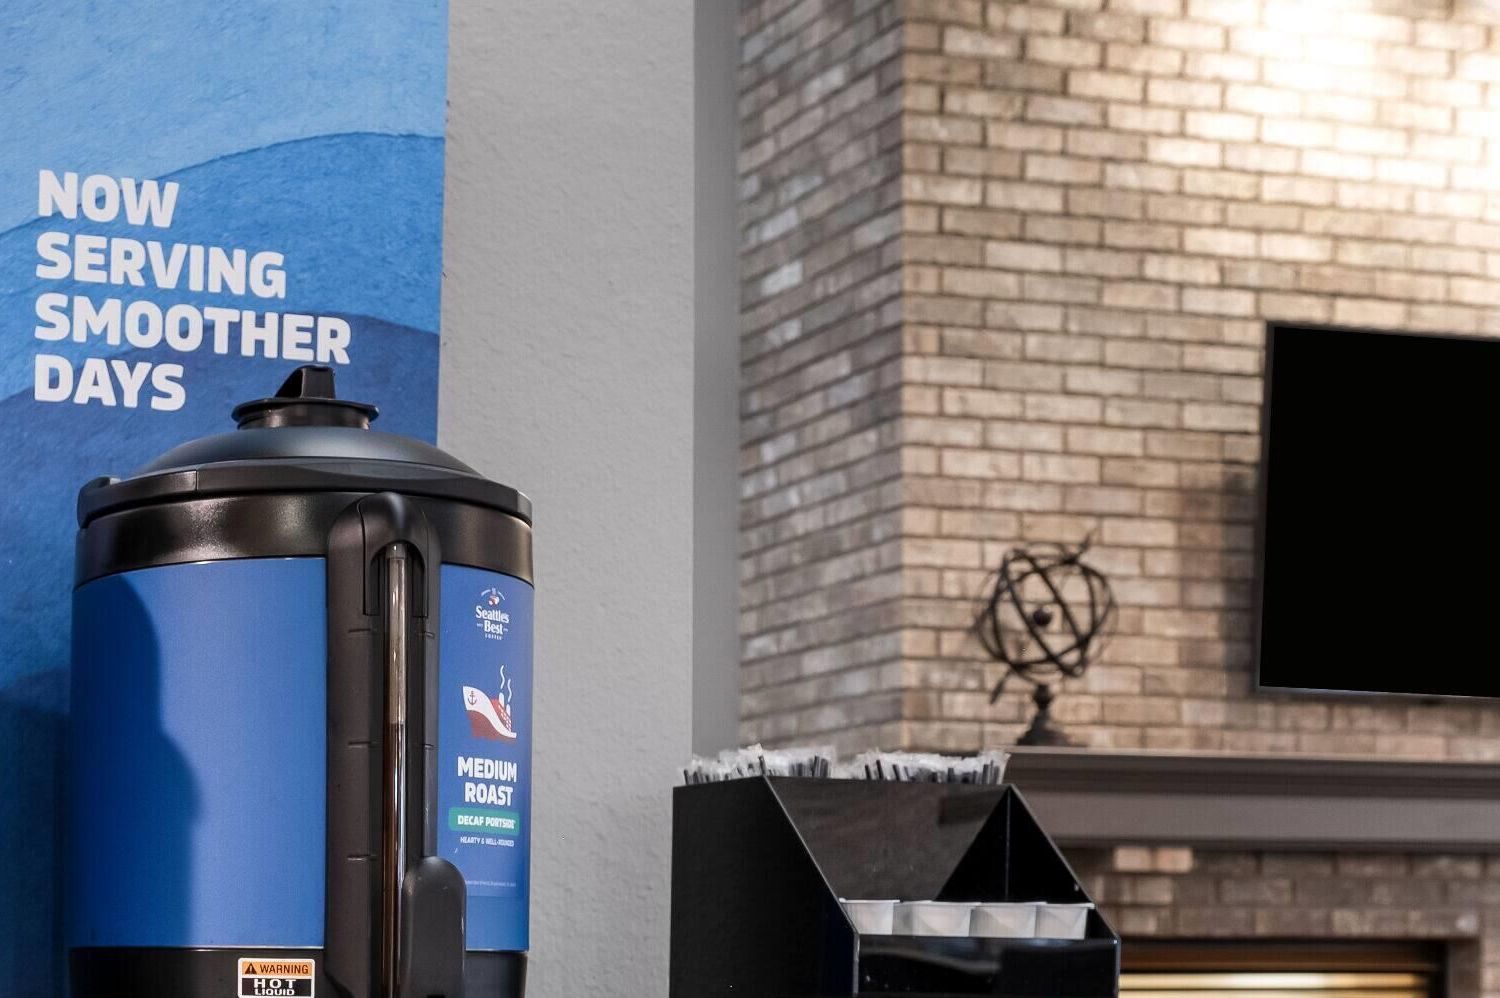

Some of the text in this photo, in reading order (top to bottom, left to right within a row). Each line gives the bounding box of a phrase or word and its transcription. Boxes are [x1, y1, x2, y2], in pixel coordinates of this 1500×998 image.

[38, 169, 179, 228] NOW
[35, 231, 286, 299] SERVING
[34, 293, 352, 365] SMOOTHER
[34, 354, 186, 412] DAYS
[484, 620, 503, 635] Best
[457, 756, 517, 782] MEDIUM
[464, 782, 514, 806] ROAST
[457, 814, 484, 826] DECAF
[460, 836, 481, 845] HEARTY
[260, 964, 309, 975] WARNING
[253, 978, 297, 989] HOT
[254, 988, 296, 996] LIQUID
